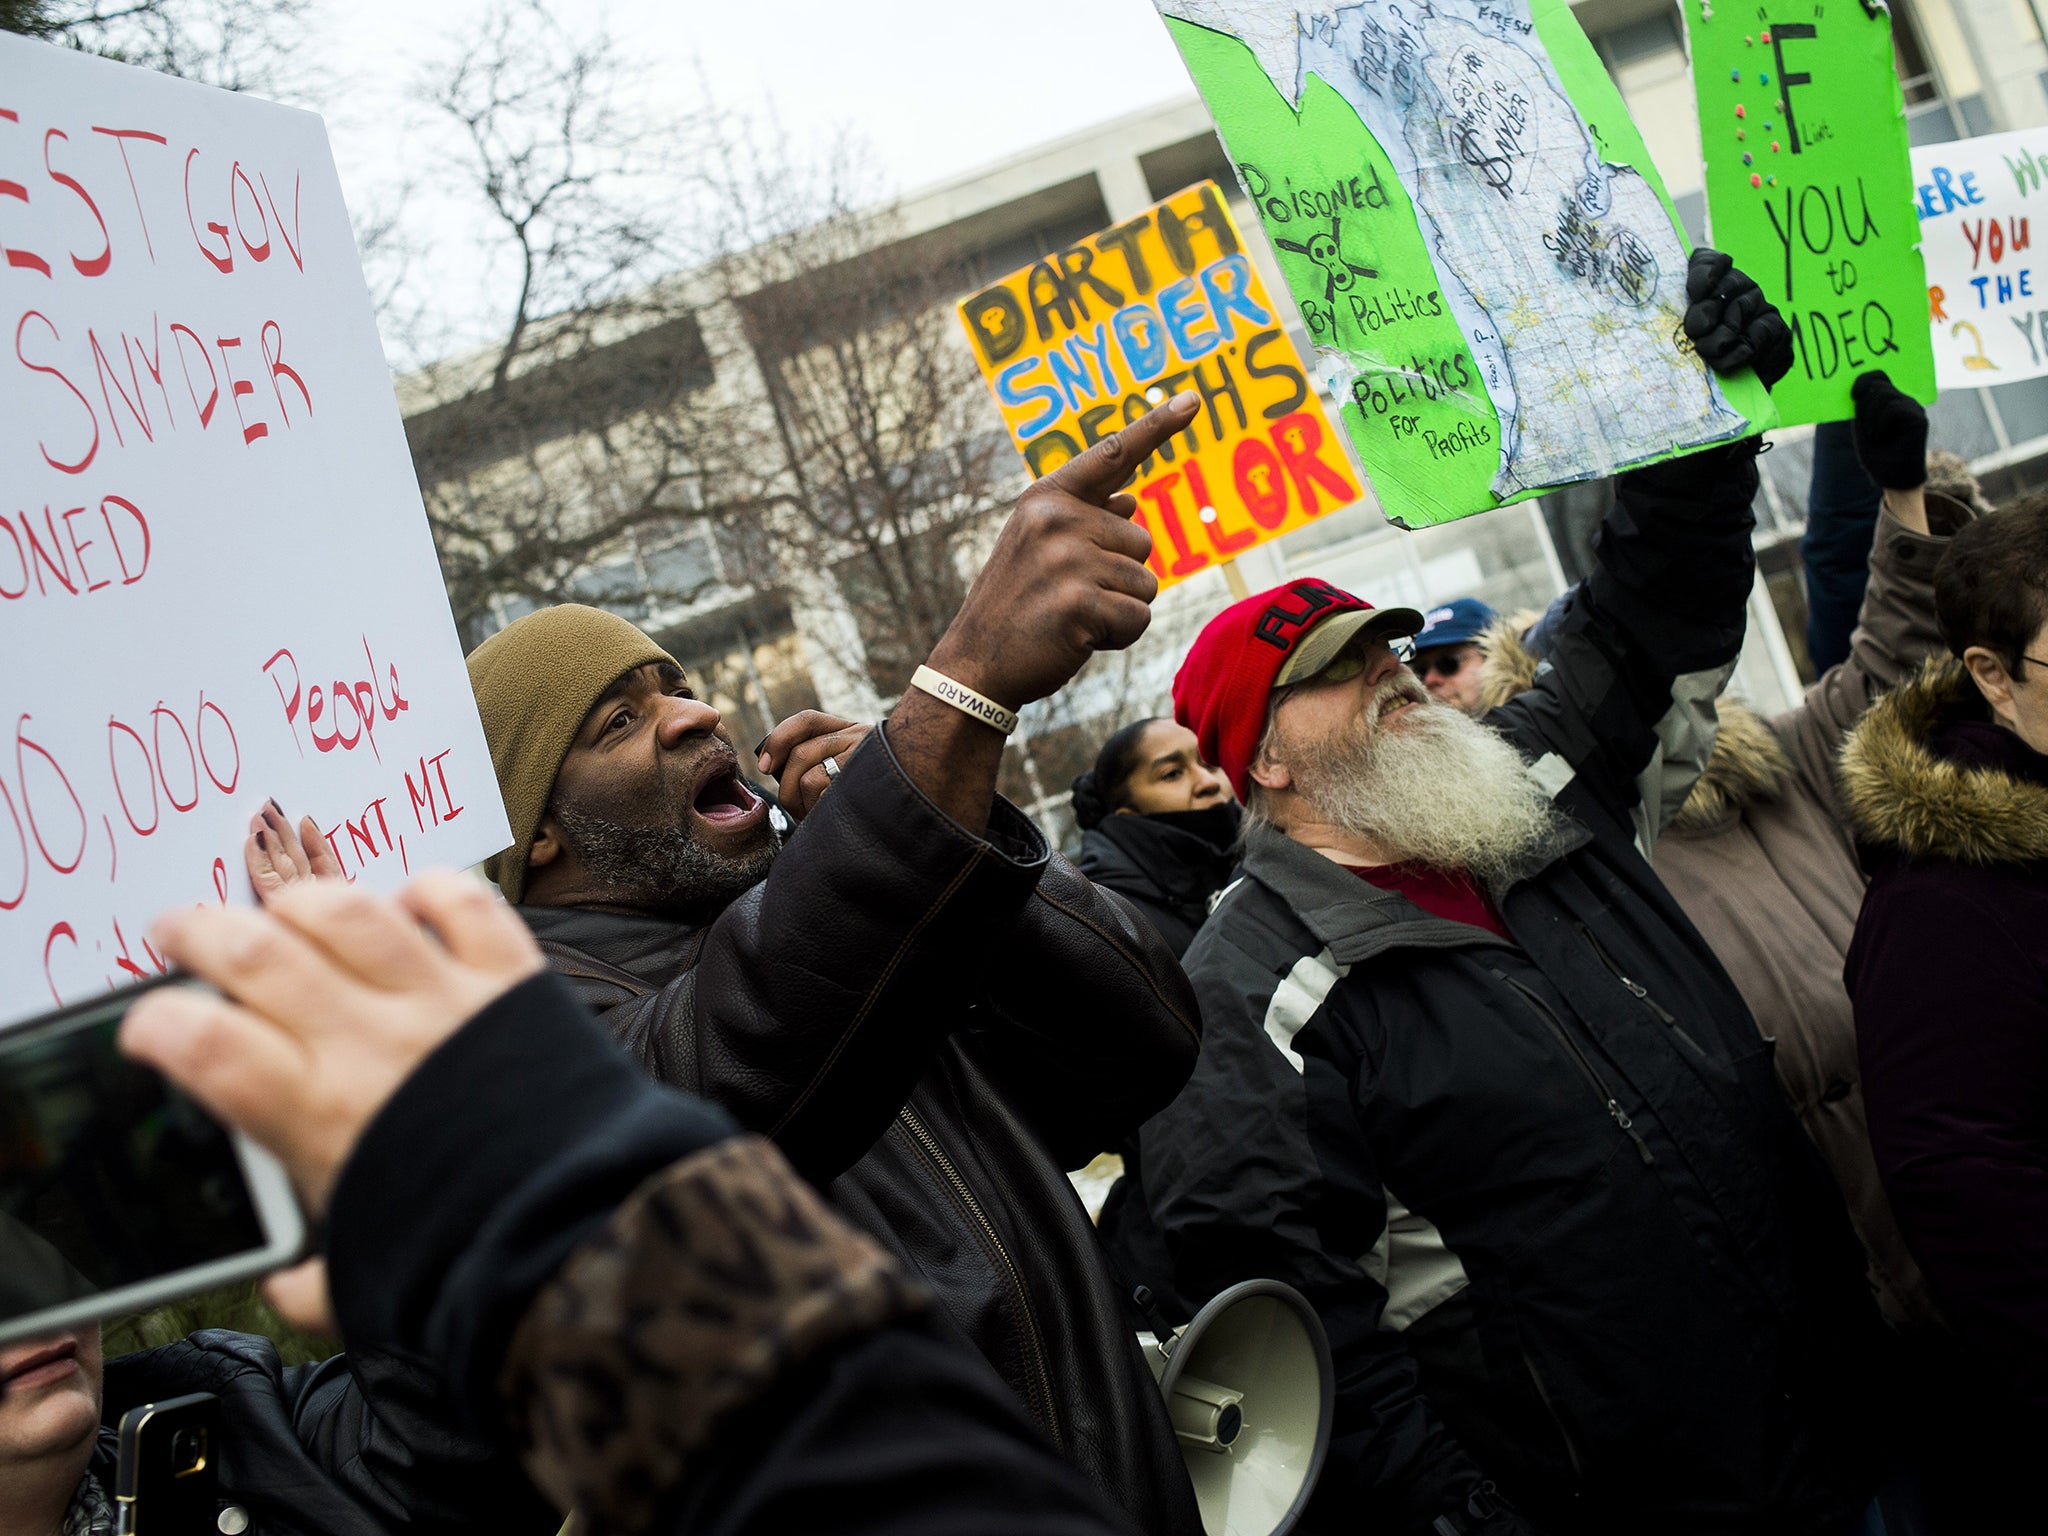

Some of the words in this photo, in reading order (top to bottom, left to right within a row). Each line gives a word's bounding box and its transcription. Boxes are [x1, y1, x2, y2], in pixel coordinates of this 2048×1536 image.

[1479, 6, 1533, 35] FRESH
[1354, 14, 1387, 98] FRESH
[185, 148, 304, 275] GOV
[1916, 166, 1985, 220] ERE
[1764, 177, 1879, 302] YOU
[1962, 216, 2029, 270] YOU
[962, 184, 1239, 368] DARTH
[1826, 259, 1857, 296] to
[1970, 269, 2033, 310] THE
[995, 253, 1271, 439] SNYDER
[1301, 299, 1339, 342] By
[1952, 321, 2001, 371] 2
[16, 310, 313, 475] SNYDER
[263, 632, 409, 766] People
[937, 681, 1013, 731] FORWARD
[404, 748, 464, 834] MI
